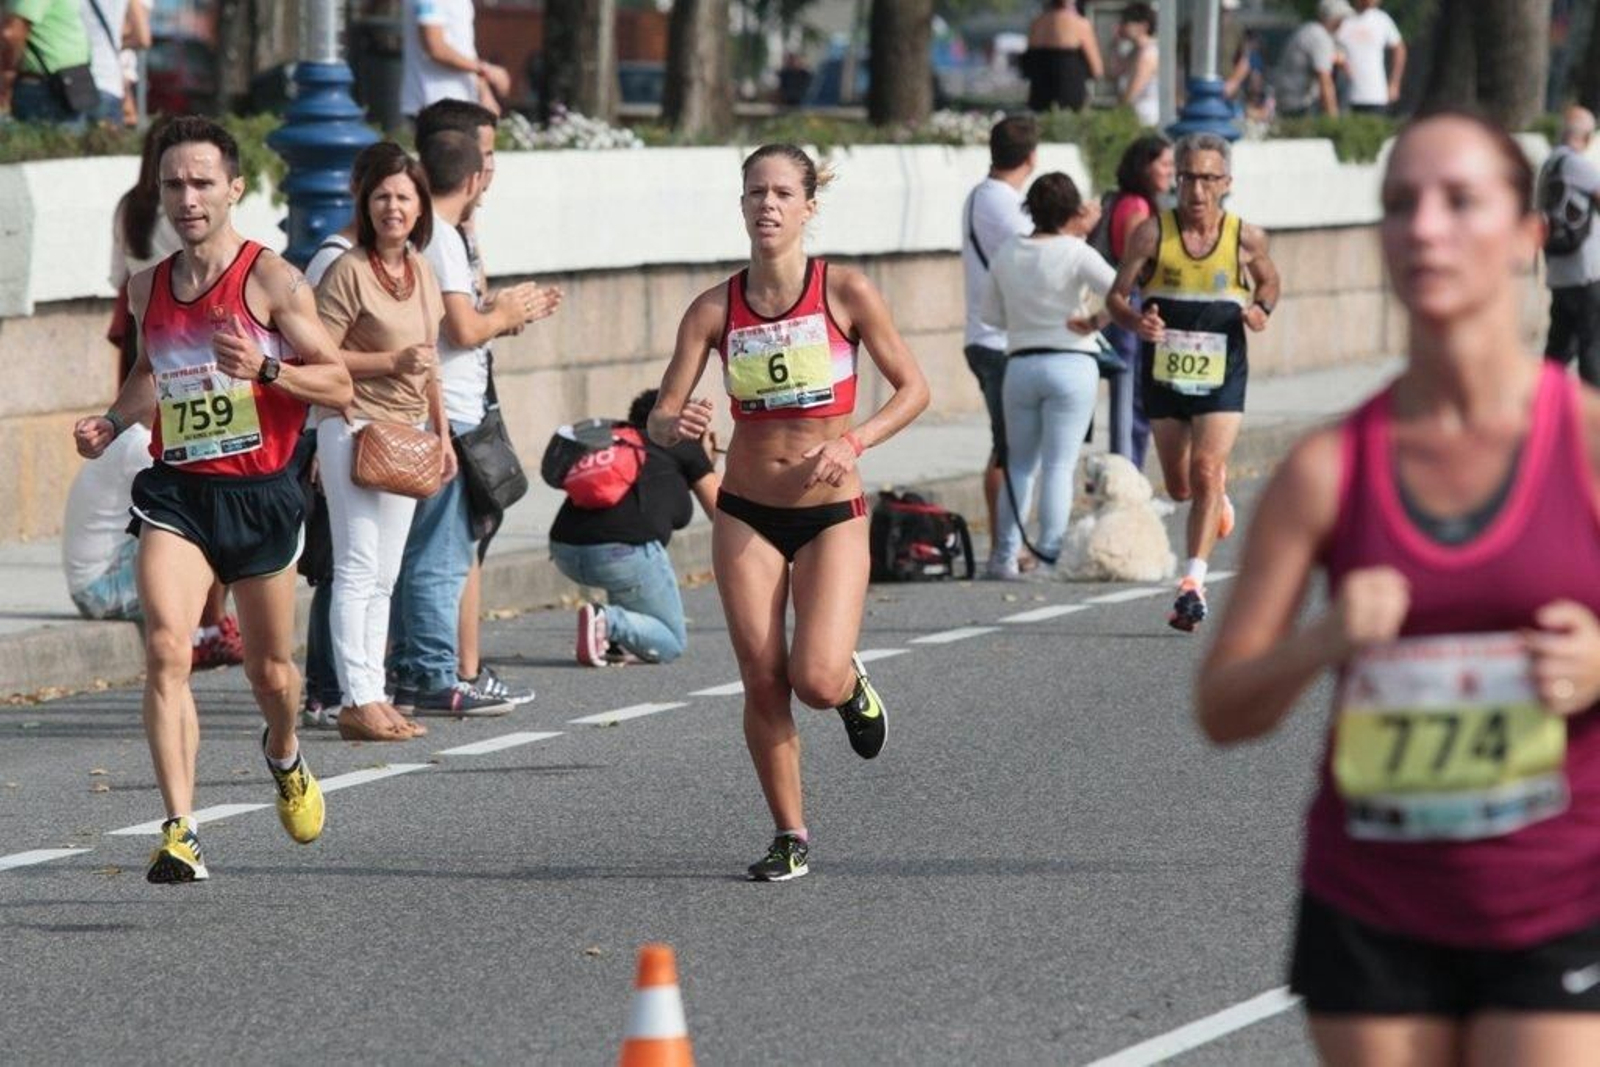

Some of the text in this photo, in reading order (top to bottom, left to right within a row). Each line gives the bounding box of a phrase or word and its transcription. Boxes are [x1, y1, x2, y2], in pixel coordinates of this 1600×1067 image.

[768, 353, 788, 384] 6
[1166, 352, 1210, 375] 802
[172, 395, 233, 433] 759
[1377, 711, 1509, 772] 774
